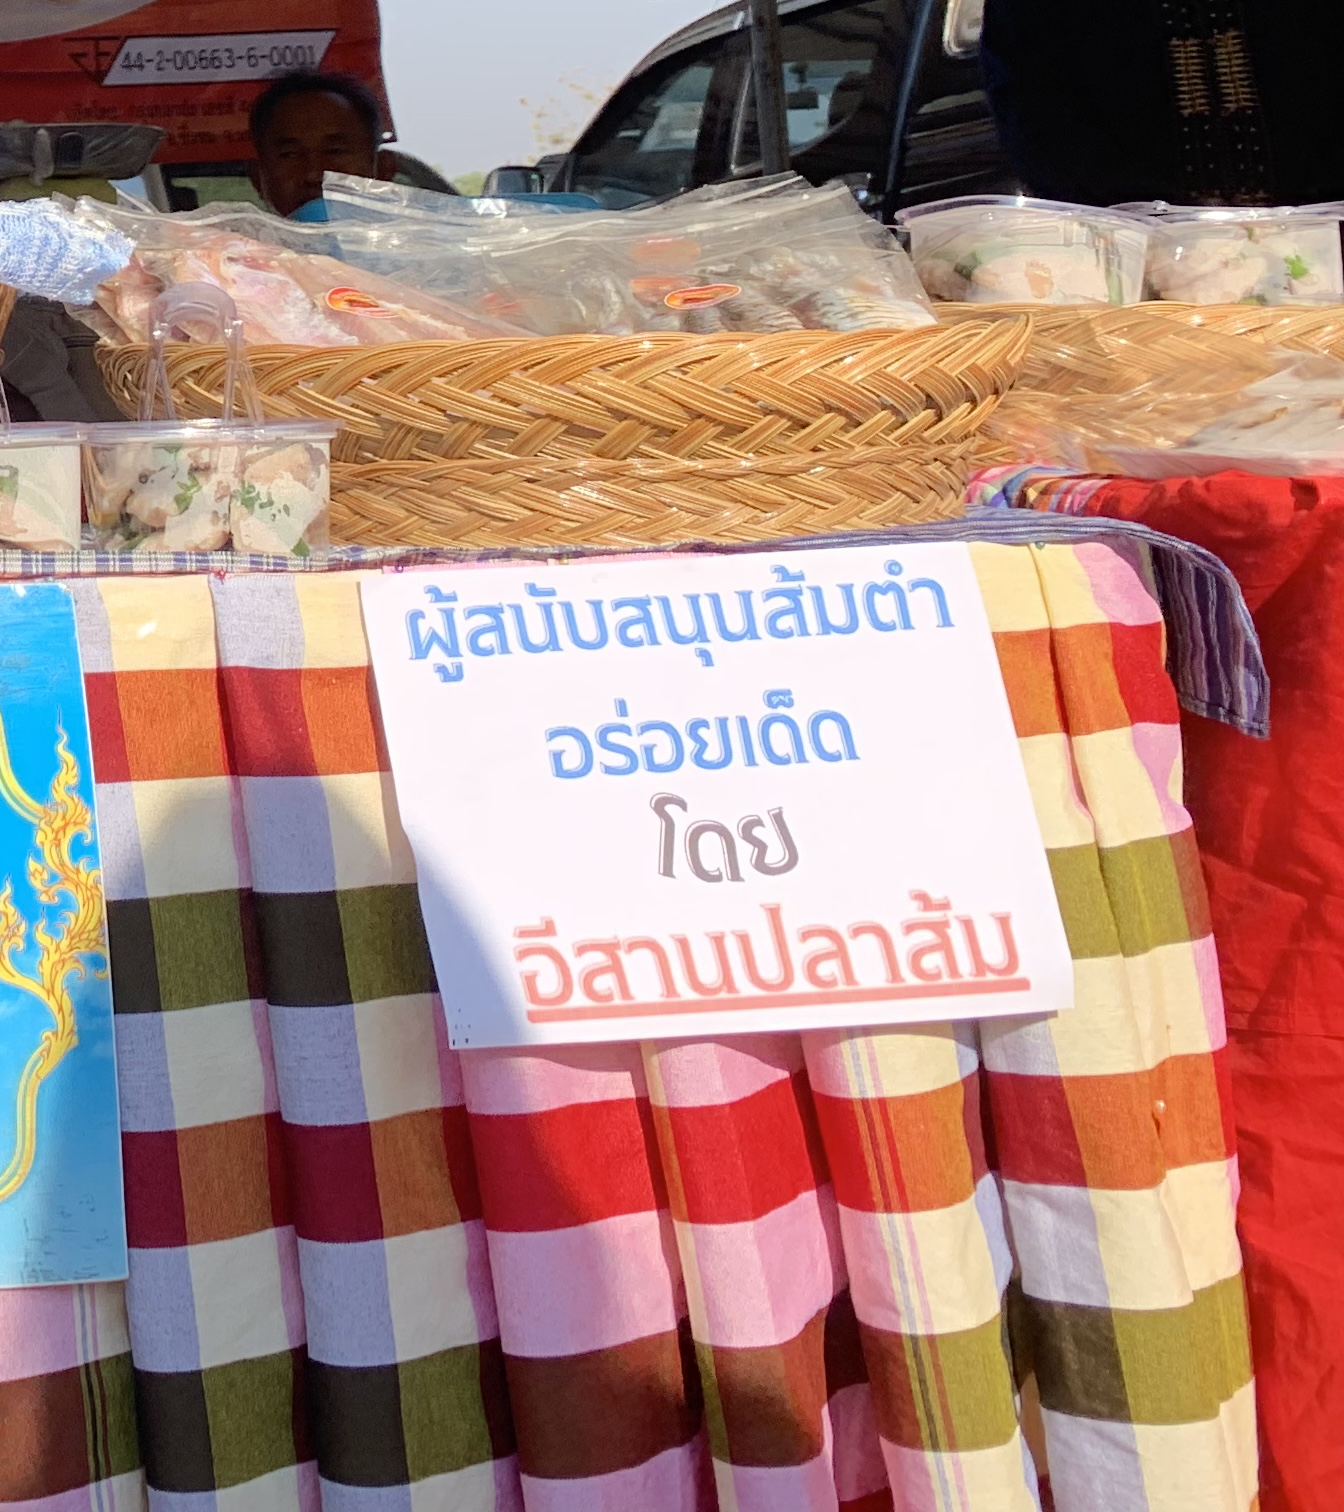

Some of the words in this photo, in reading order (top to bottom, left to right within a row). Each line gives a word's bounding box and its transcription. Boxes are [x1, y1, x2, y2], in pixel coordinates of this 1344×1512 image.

[406, 558, 955, 684] ผู้สนับสนุนส้มตำ
[546, 688, 860, 780] อร่อยเด็ด
[648, 792, 800, 884] โดย
[514, 891, 1020, 1011] อีสานปลาส้ม
